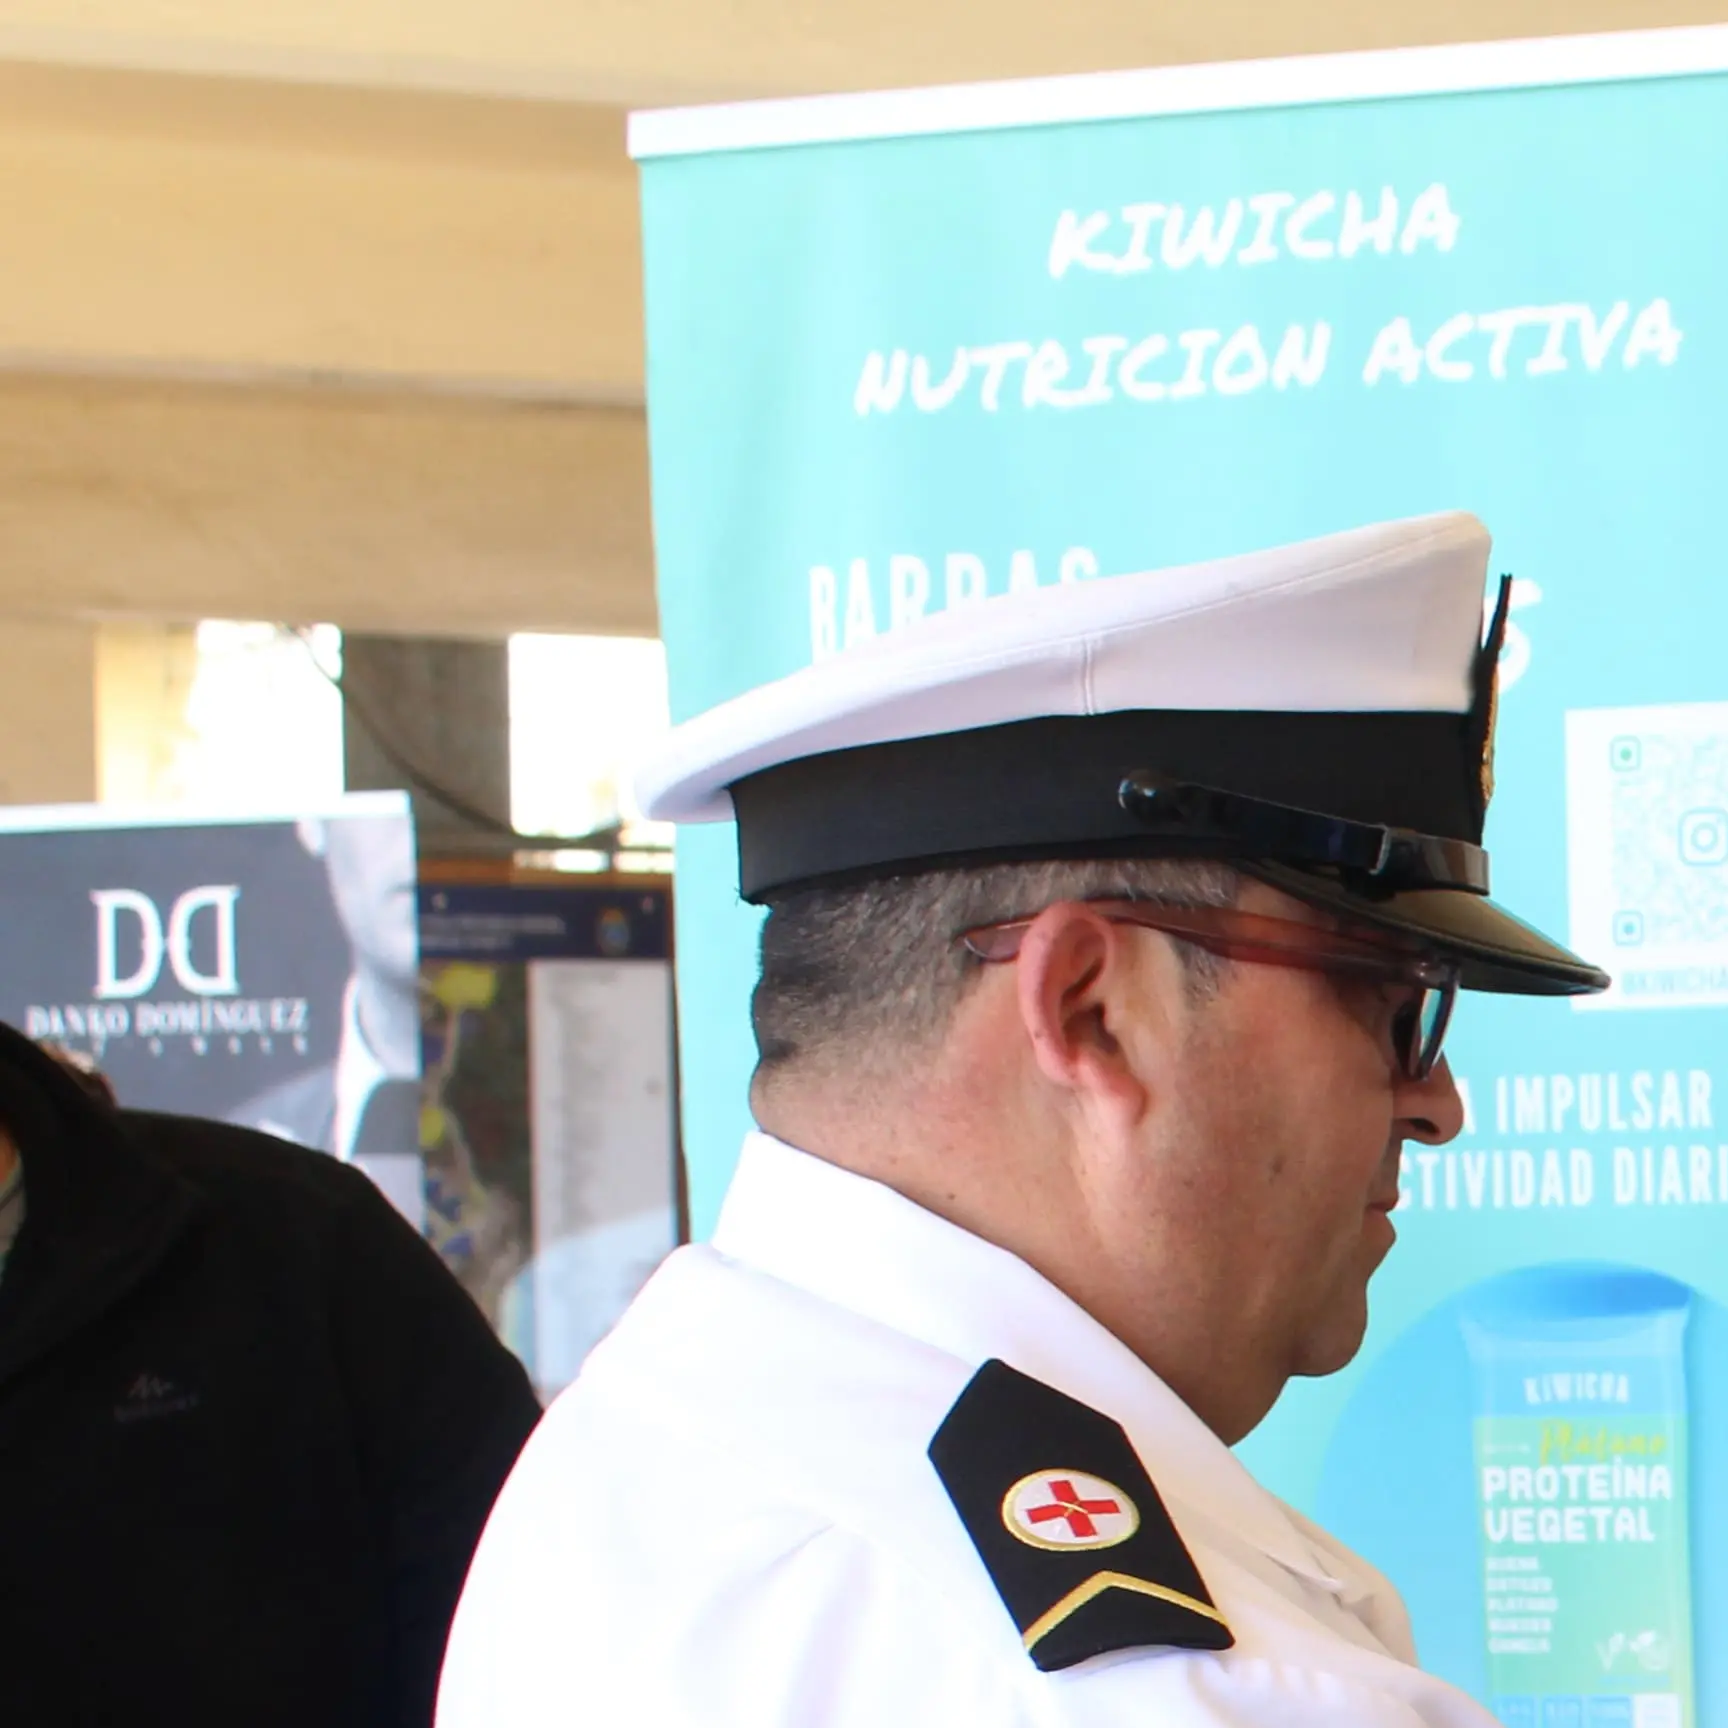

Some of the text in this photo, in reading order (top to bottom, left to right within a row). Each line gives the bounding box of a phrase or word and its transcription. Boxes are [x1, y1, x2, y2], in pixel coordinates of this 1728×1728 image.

[1048, 183, 1461, 279] KIWICHA
[855, 301, 1683, 413] NUTRICION ACTIVA
[1496, 1072, 1712, 1133] IMPULSAR
[1397, 1150, 1594, 1211] CTIVIDAD
[1483, 1456, 1672, 1500] PROTEÍNA
[1485, 1508, 1655, 1541] VEGETAL
